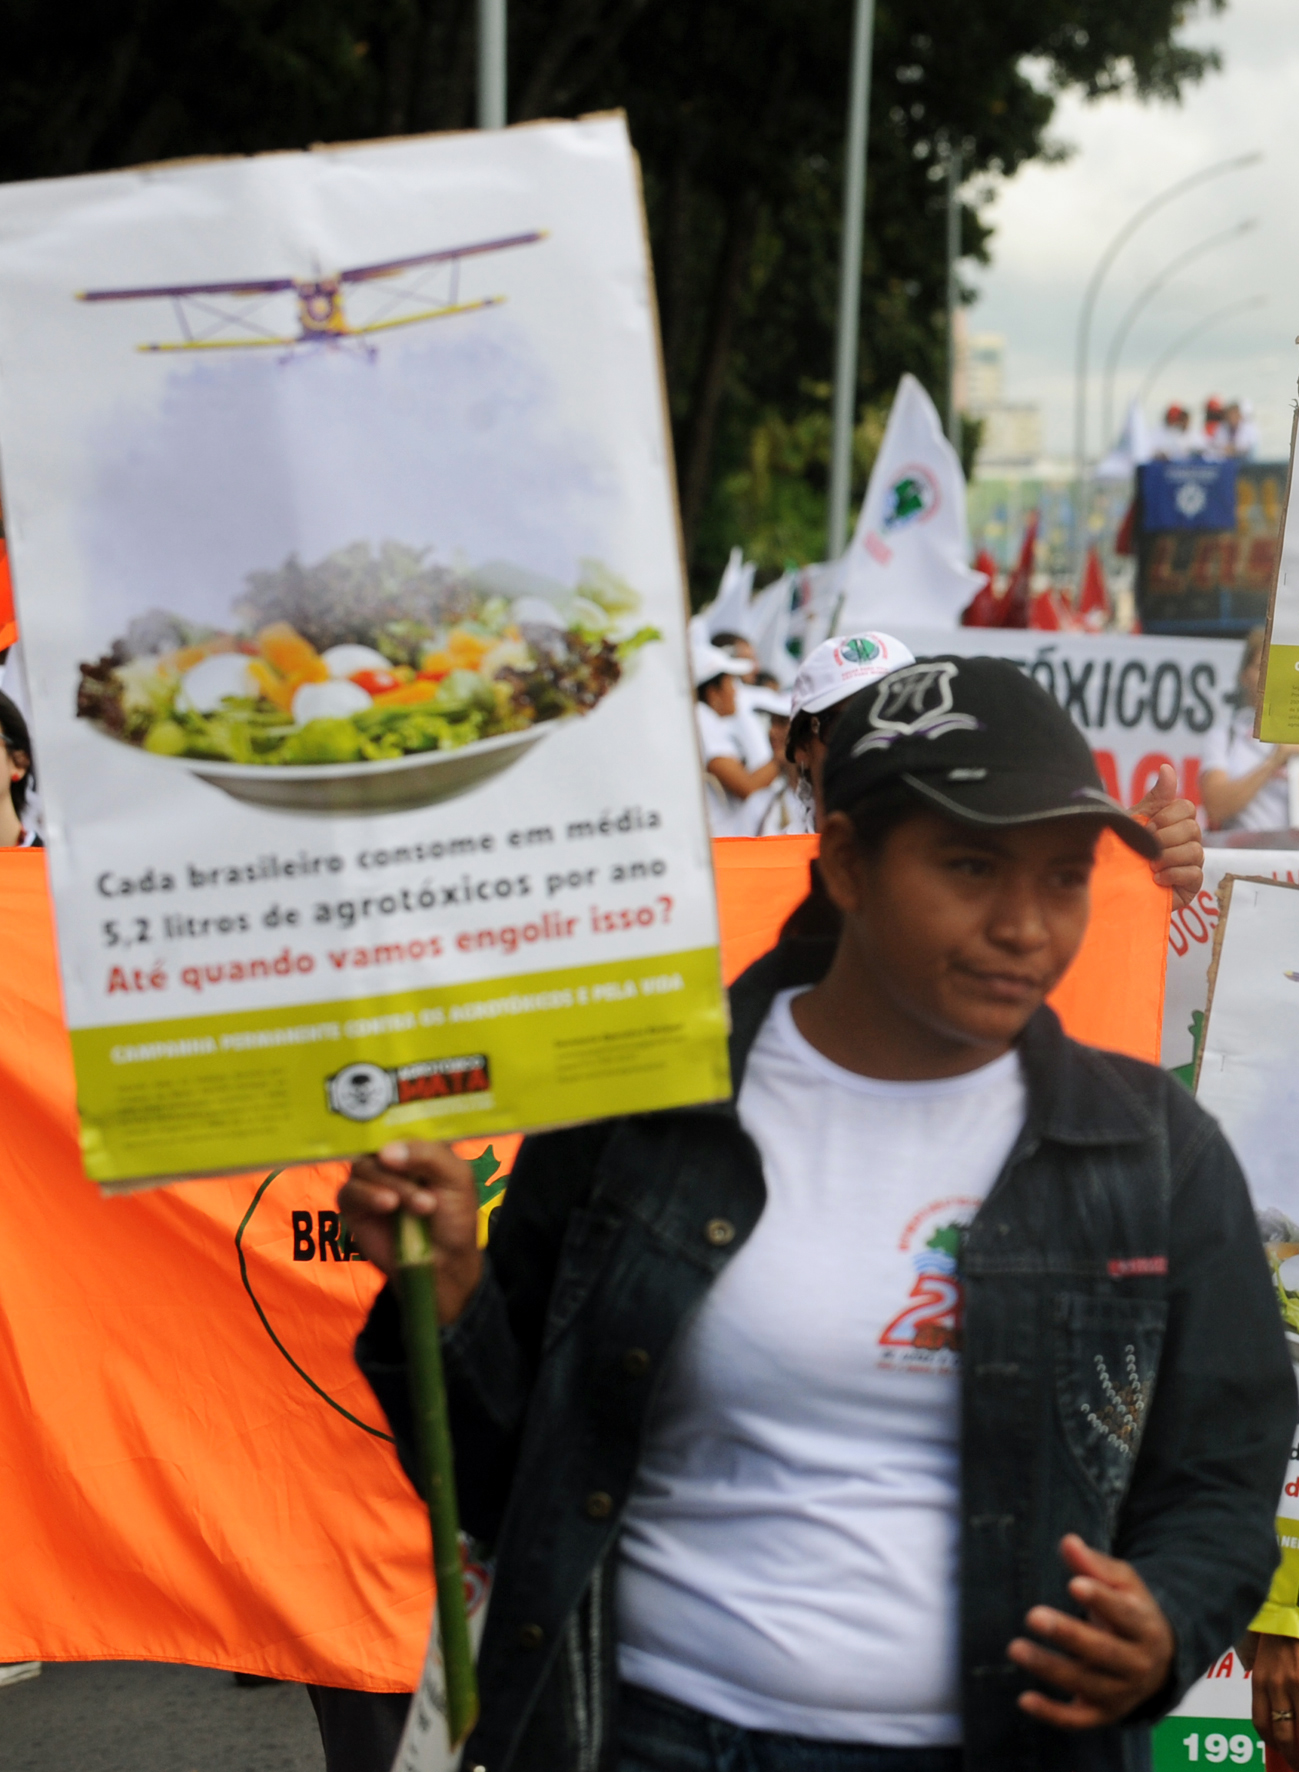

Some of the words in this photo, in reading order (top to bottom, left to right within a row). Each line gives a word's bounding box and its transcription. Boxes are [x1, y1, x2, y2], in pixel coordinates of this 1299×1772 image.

[96, 869, 176, 898] Cada
[187, 855, 343, 889] brasileiro
[356, 834, 494, 870] consome
[507, 826, 554, 848] em
[566, 809, 661, 839] média
[103, 917, 150, 947] 5,2
[163, 914, 250, 940] litros
[262, 905, 299, 929] de
[312, 876, 531, 930] agrotóxicos
[545, 868, 597, 897] por
[611, 859, 666, 883] ano
[107, 966, 167, 994] Até
[180, 948, 316, 992] quando
[328, 936, 443, 970] vamos
[455, 912, 578, 954] engolir
[591, 894, 675, 933] isso?
